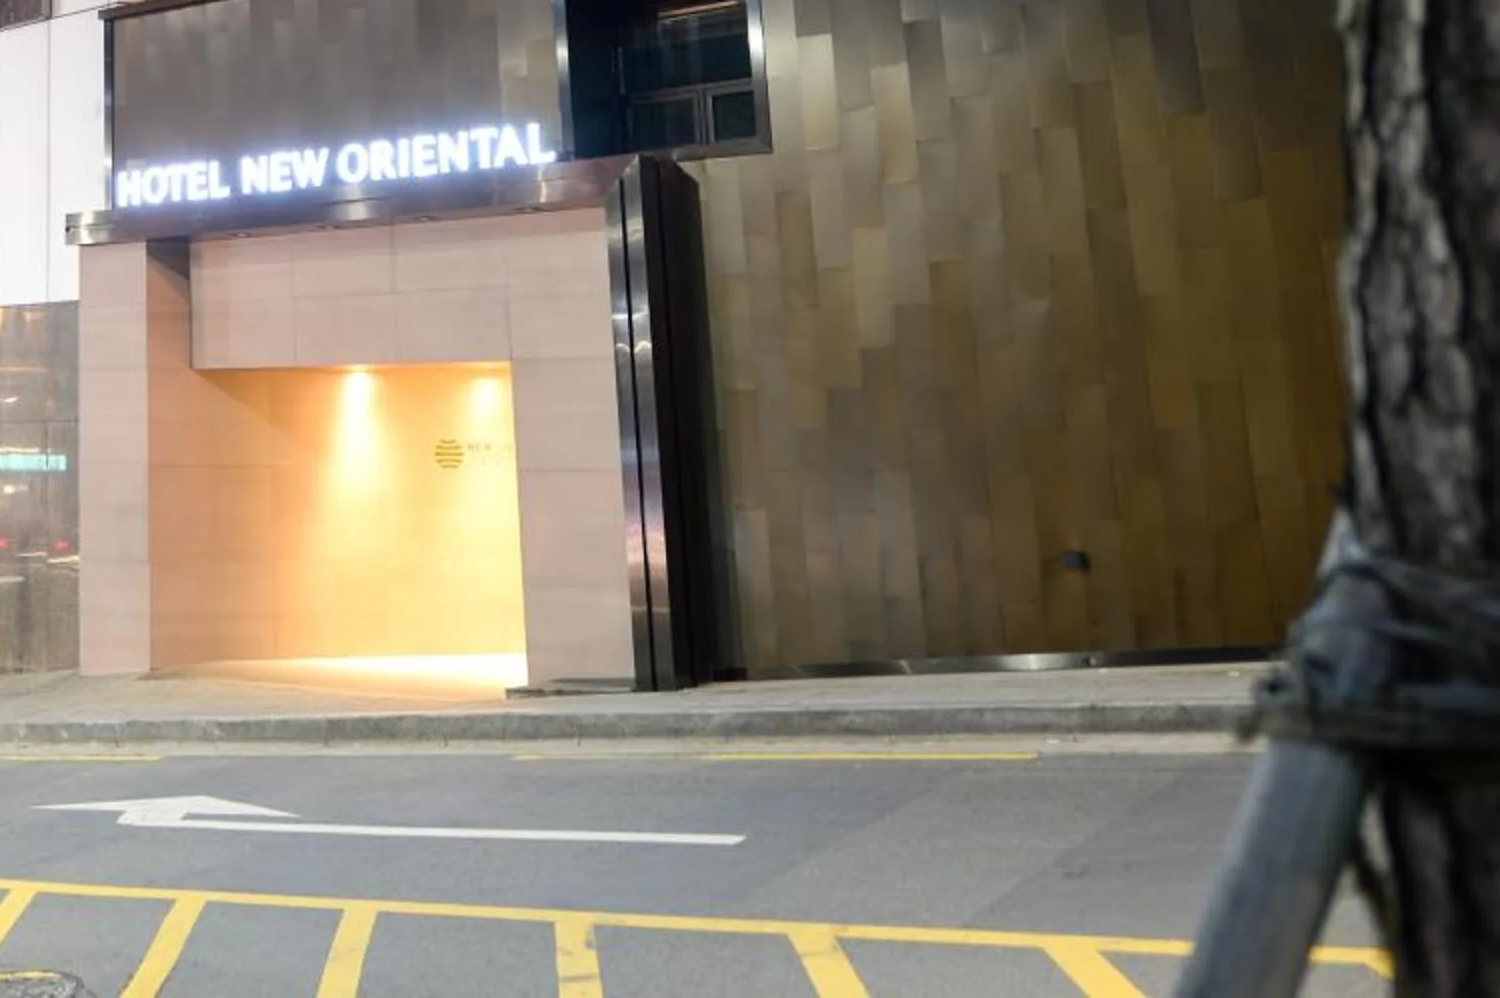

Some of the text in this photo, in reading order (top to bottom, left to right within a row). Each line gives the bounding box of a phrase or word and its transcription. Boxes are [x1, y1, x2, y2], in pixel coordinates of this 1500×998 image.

[117, 122, 557, 208] HOTEL NEW ORIENTAL
